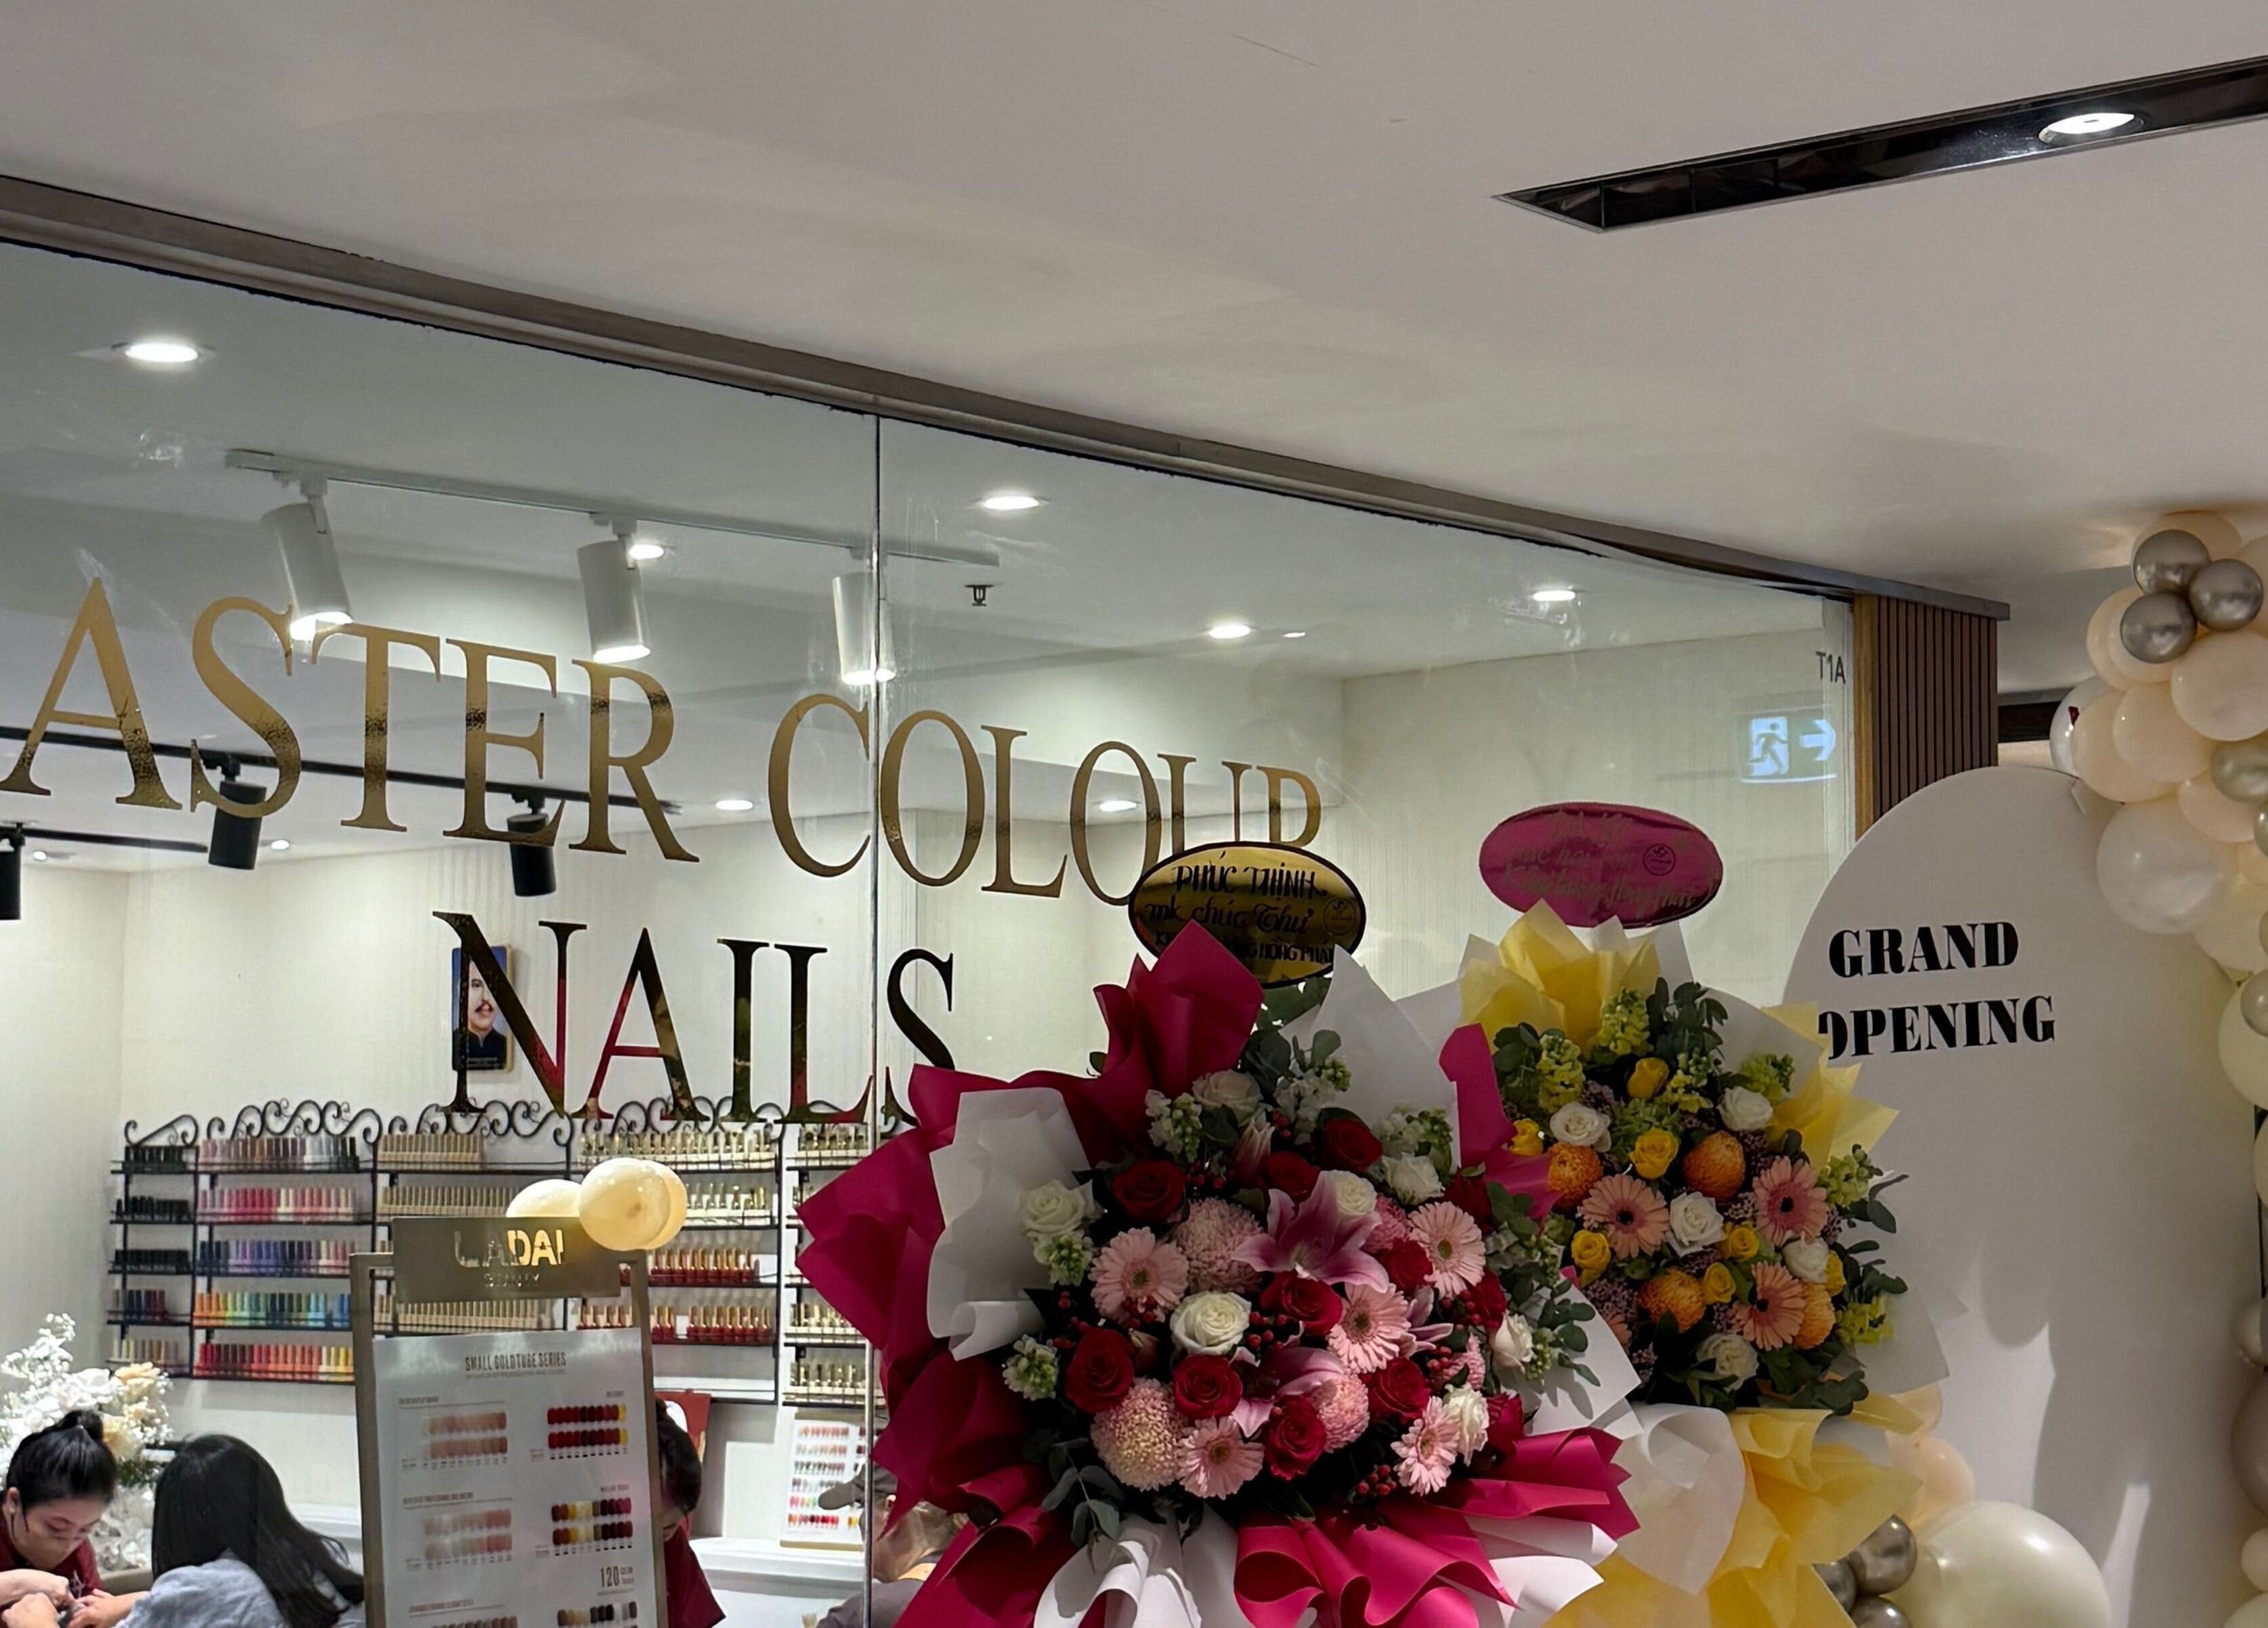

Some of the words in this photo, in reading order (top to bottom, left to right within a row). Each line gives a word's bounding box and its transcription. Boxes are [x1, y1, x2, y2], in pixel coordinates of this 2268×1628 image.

[1815, 651, 1846, 684] T1A
[0, 577, 700, 863] ASTER
[1829, 921, 2019, 977] GRAND
[432, 910, 955, 1127] NAILS
[538, 1351, 567, 1367] SERIES
[600, 1566, 619, 1587] 120
